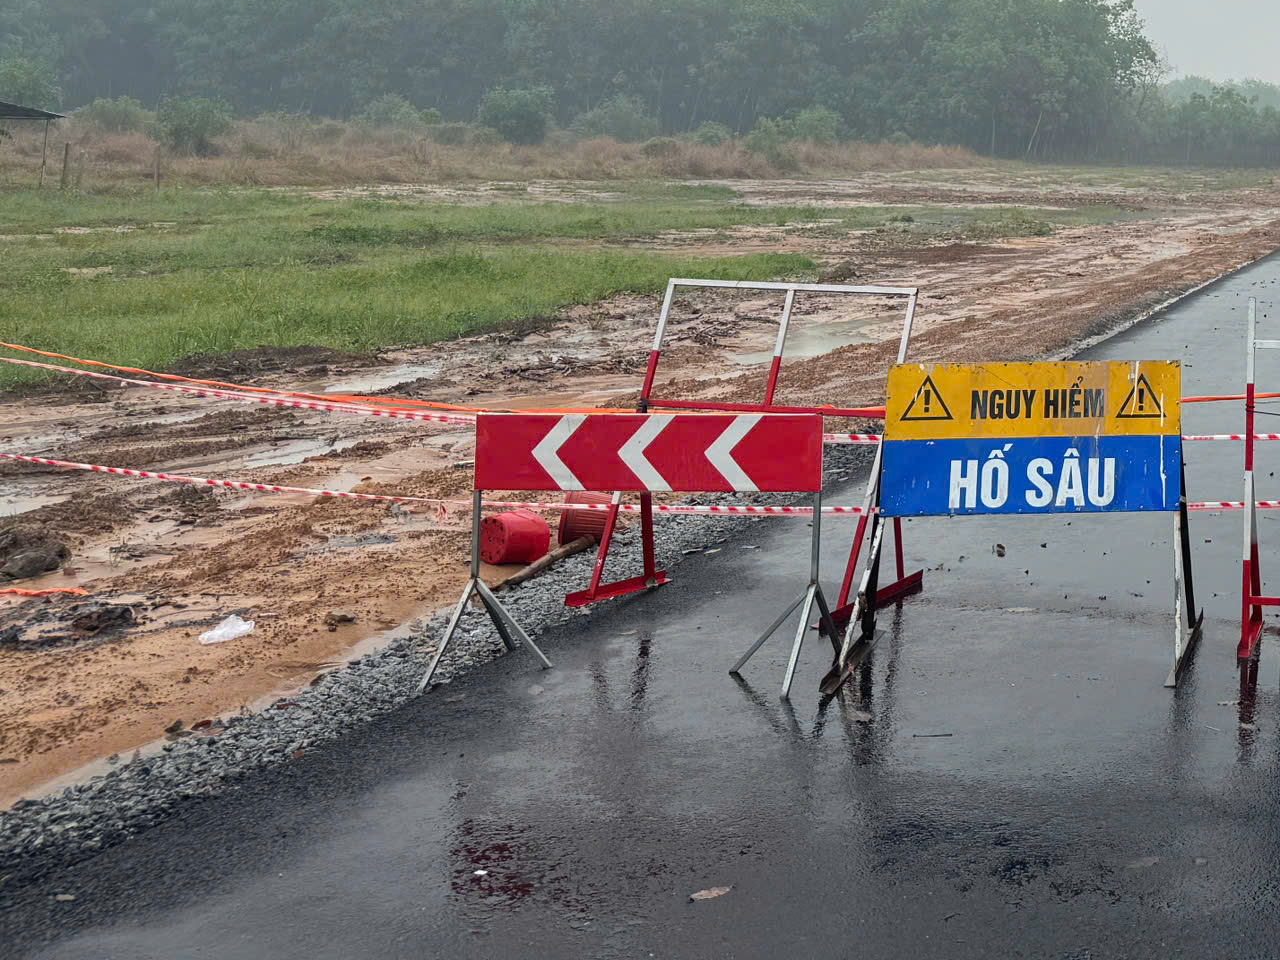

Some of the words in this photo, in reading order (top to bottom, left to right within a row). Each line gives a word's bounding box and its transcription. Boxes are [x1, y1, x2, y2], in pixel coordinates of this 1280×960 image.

[970, 389, 1036, 420] NGUY
[1044, 376, 1105, 419] HIỂM
[948, 443, 1013, 509] HỐ
[1025, 448, 1116, 508] SÂU
